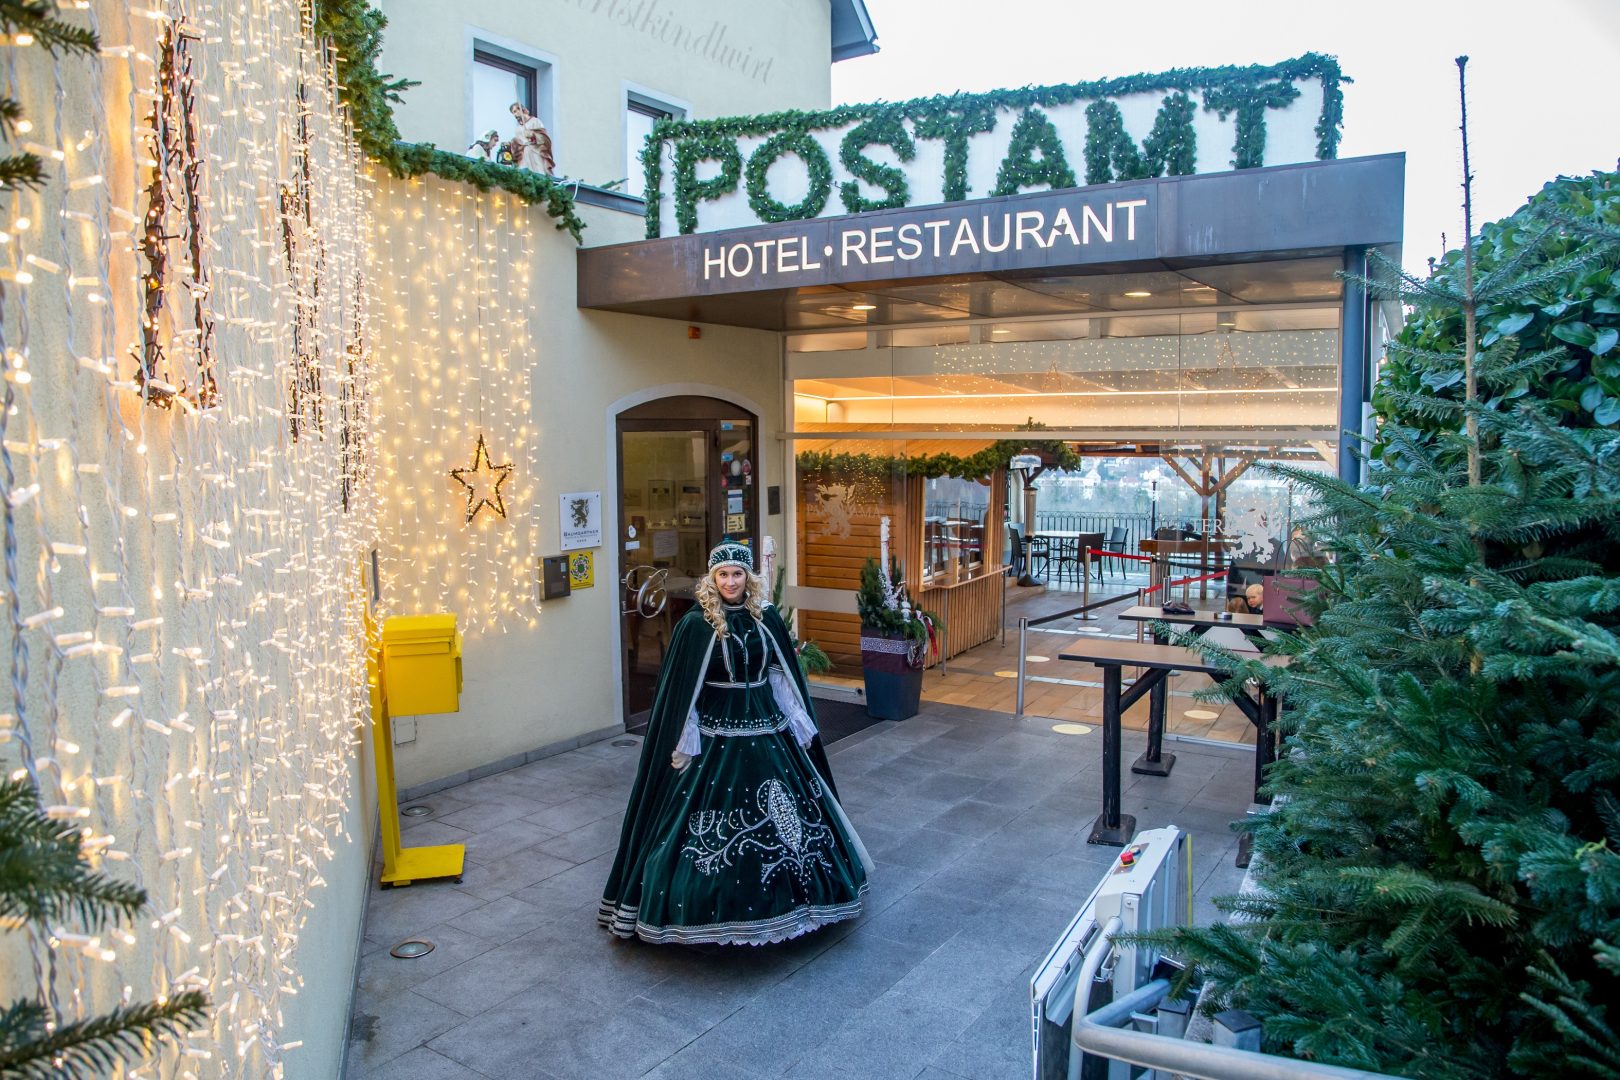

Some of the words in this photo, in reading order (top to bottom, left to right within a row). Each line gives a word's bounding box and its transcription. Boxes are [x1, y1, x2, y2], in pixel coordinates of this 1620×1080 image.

[564, 0, 774, 84] ristkindlwirt
[673, 80, 1301, 235] POSTAMT
[704, 236, 821, 280] HOTEL
[841, 199, 1147, 267] RESTAURANT
